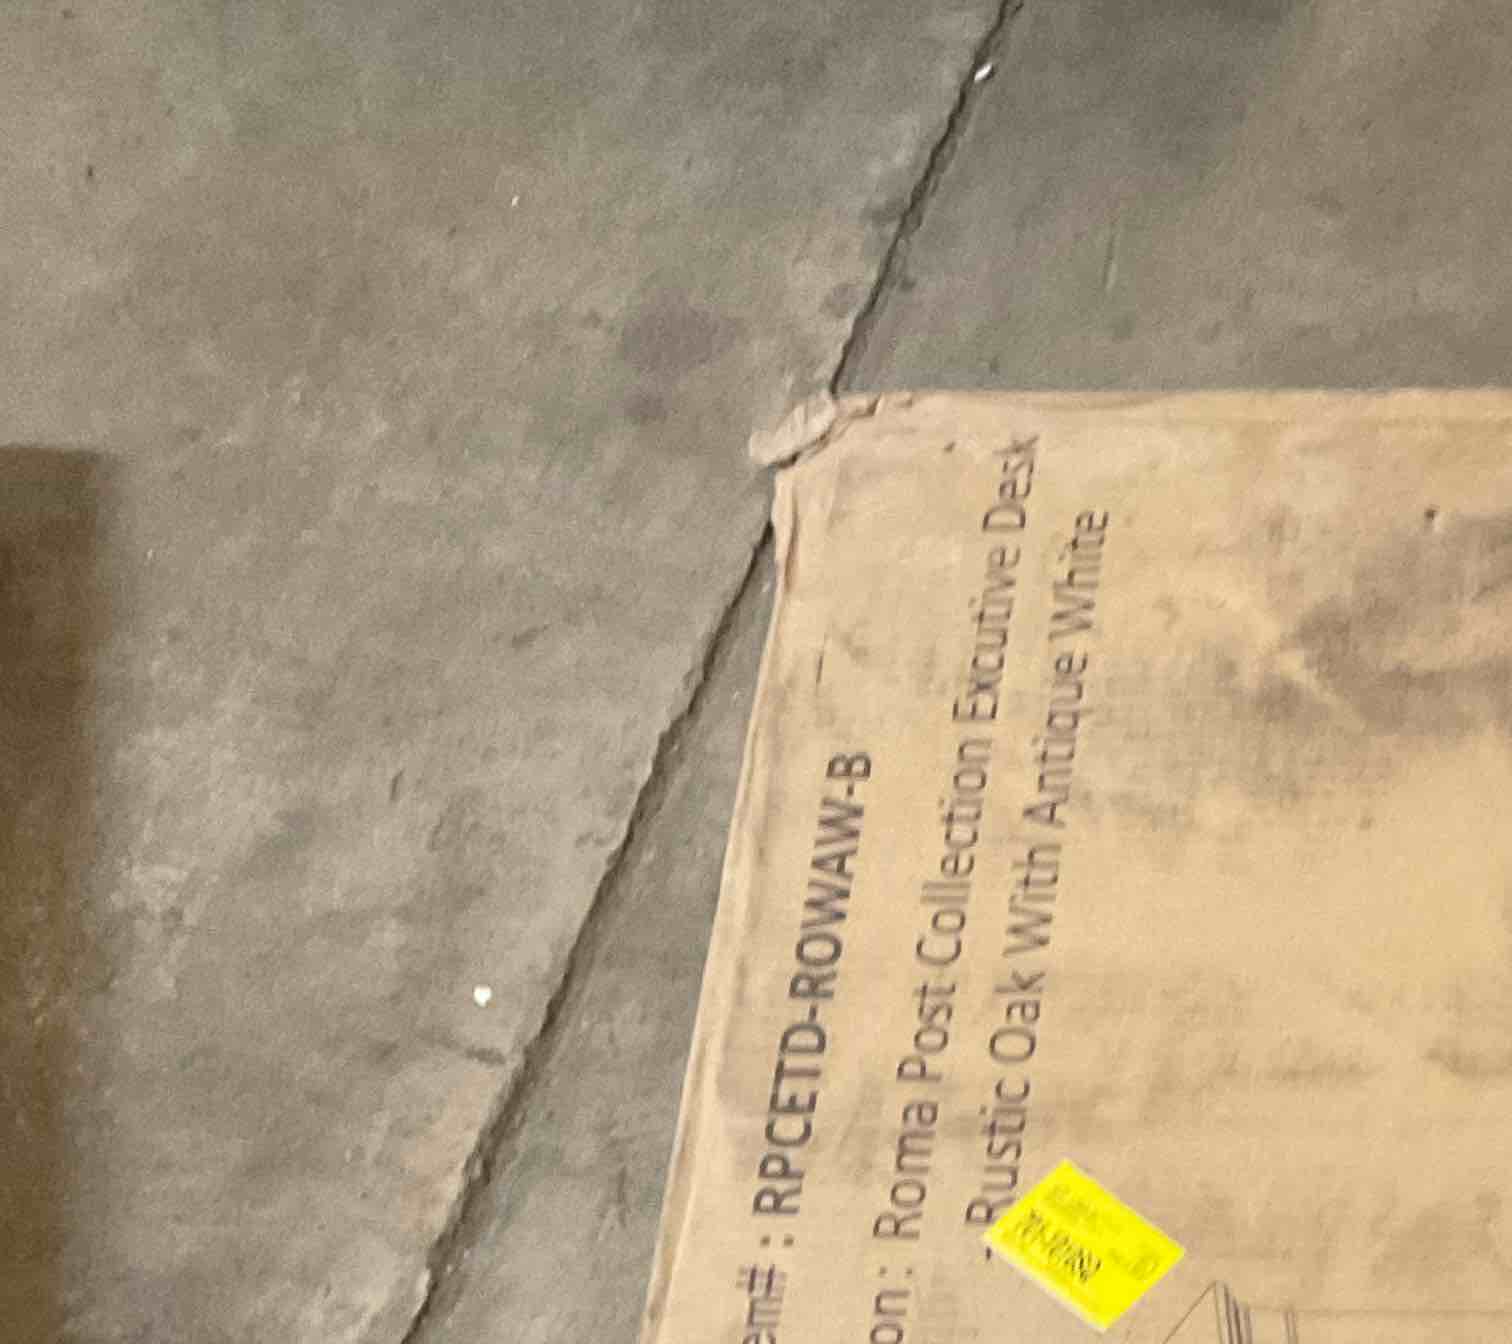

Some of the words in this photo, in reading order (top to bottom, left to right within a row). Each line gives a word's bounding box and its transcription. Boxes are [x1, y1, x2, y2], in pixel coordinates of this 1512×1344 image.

[982, 434, 1039, 532] Desk
[952, 547, 1021, 721] Excutive
[1049, 510, 1109, 641] White
[1022, 652, 1093, 828] Antique
[916, 739, 992, 968] Collection
[1002, 843, 1062, 958] With
[752, 752, 871, 1215] RPCETD-ROWAW-B
[897, 980, 957, 1083] Post
[989, 970, 1046, 1064] Oak
[873, 1100, 938, 1240] Roma
[965, 1076, 1031, 1227] Rustic
